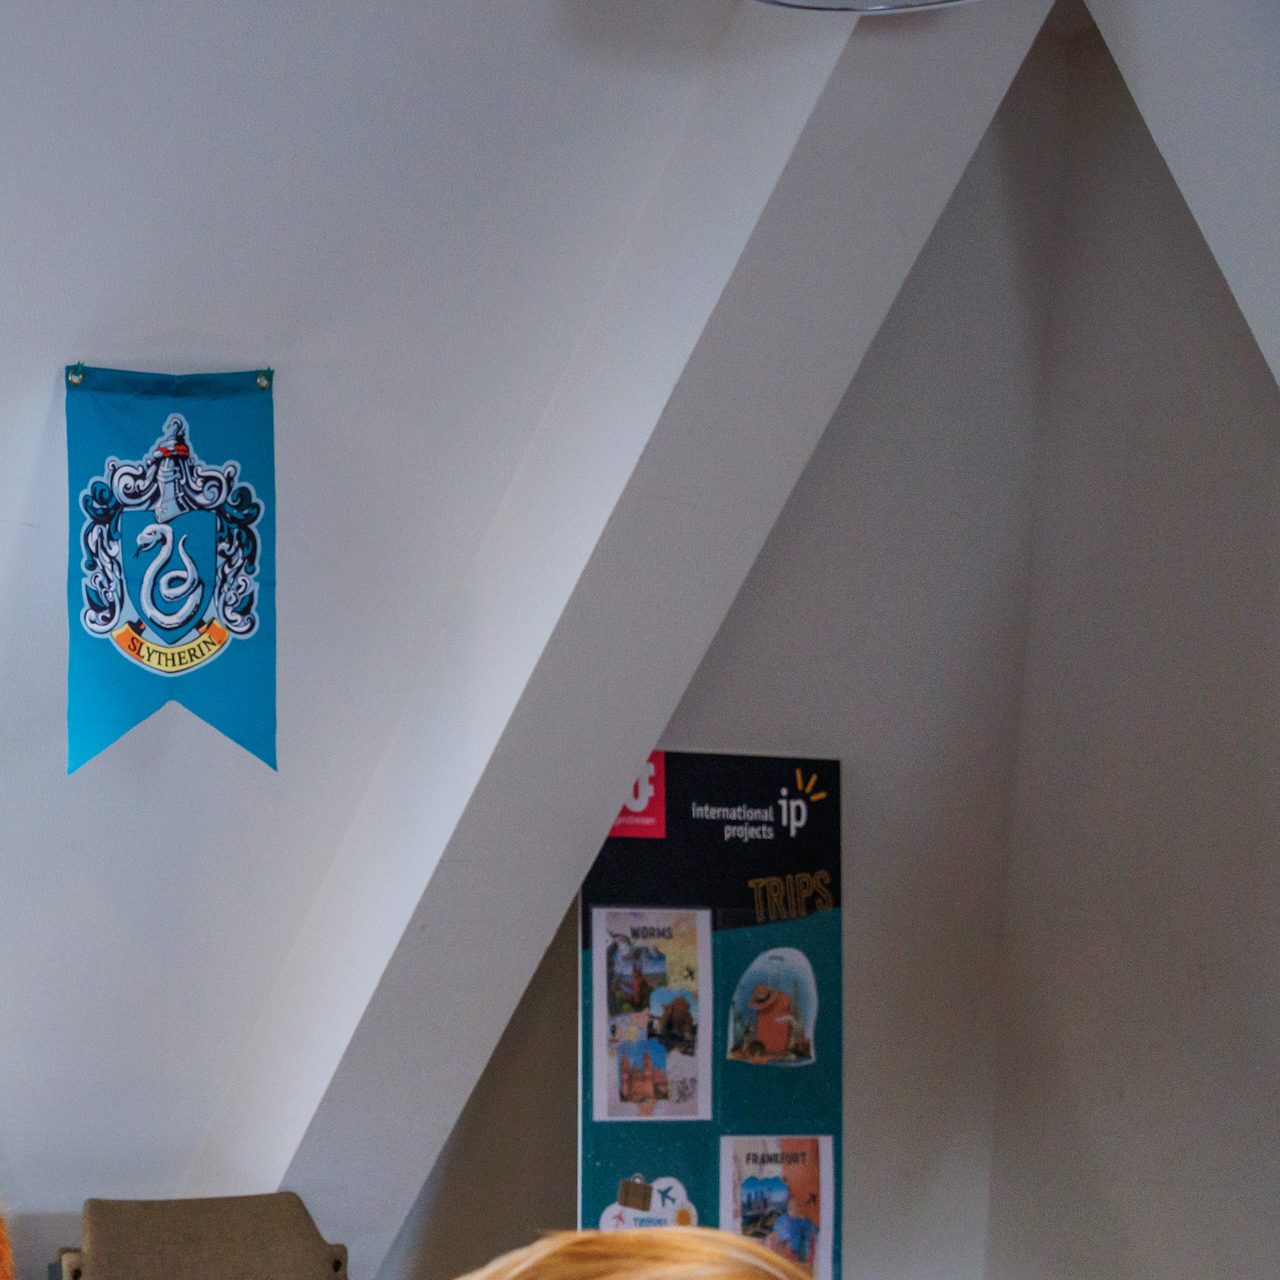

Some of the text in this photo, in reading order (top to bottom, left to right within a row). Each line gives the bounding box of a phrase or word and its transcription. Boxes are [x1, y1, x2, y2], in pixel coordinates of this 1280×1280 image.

[127, 635, 218, 668] SLYTHERIN
[723, 822, 775, 843] projects
[777, 786, 808, 838] ip
[747, 869, 834, 924] TRIPS
